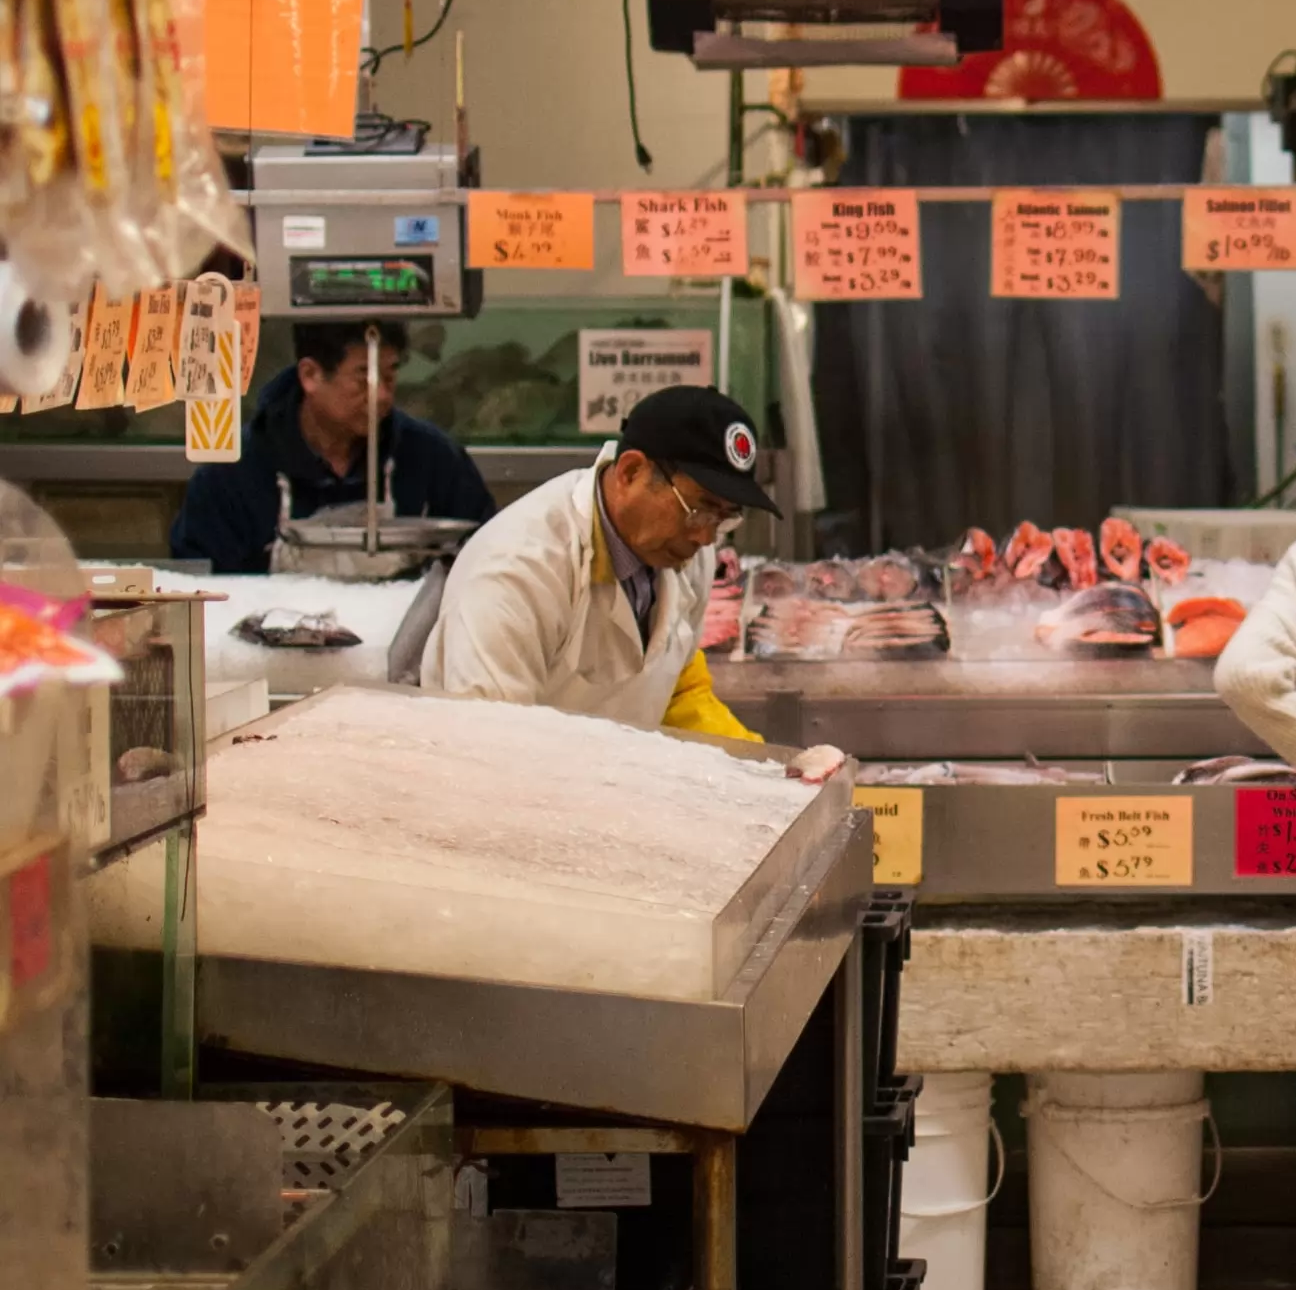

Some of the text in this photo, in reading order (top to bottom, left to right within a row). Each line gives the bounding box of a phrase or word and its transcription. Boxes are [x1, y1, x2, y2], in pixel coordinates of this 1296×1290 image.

[637, 196, 728, 213] Shark Fish
[832, 201, 895, 218] King Fish
[1206, 198, 1256, 213] Salmon
[536, 209, 563, 221] Fish
[589, 350, 618, 366] Live
[1266, 790, 1286, 801] On
[1081, 810, 1170, 822] Fresh Belt Fish
